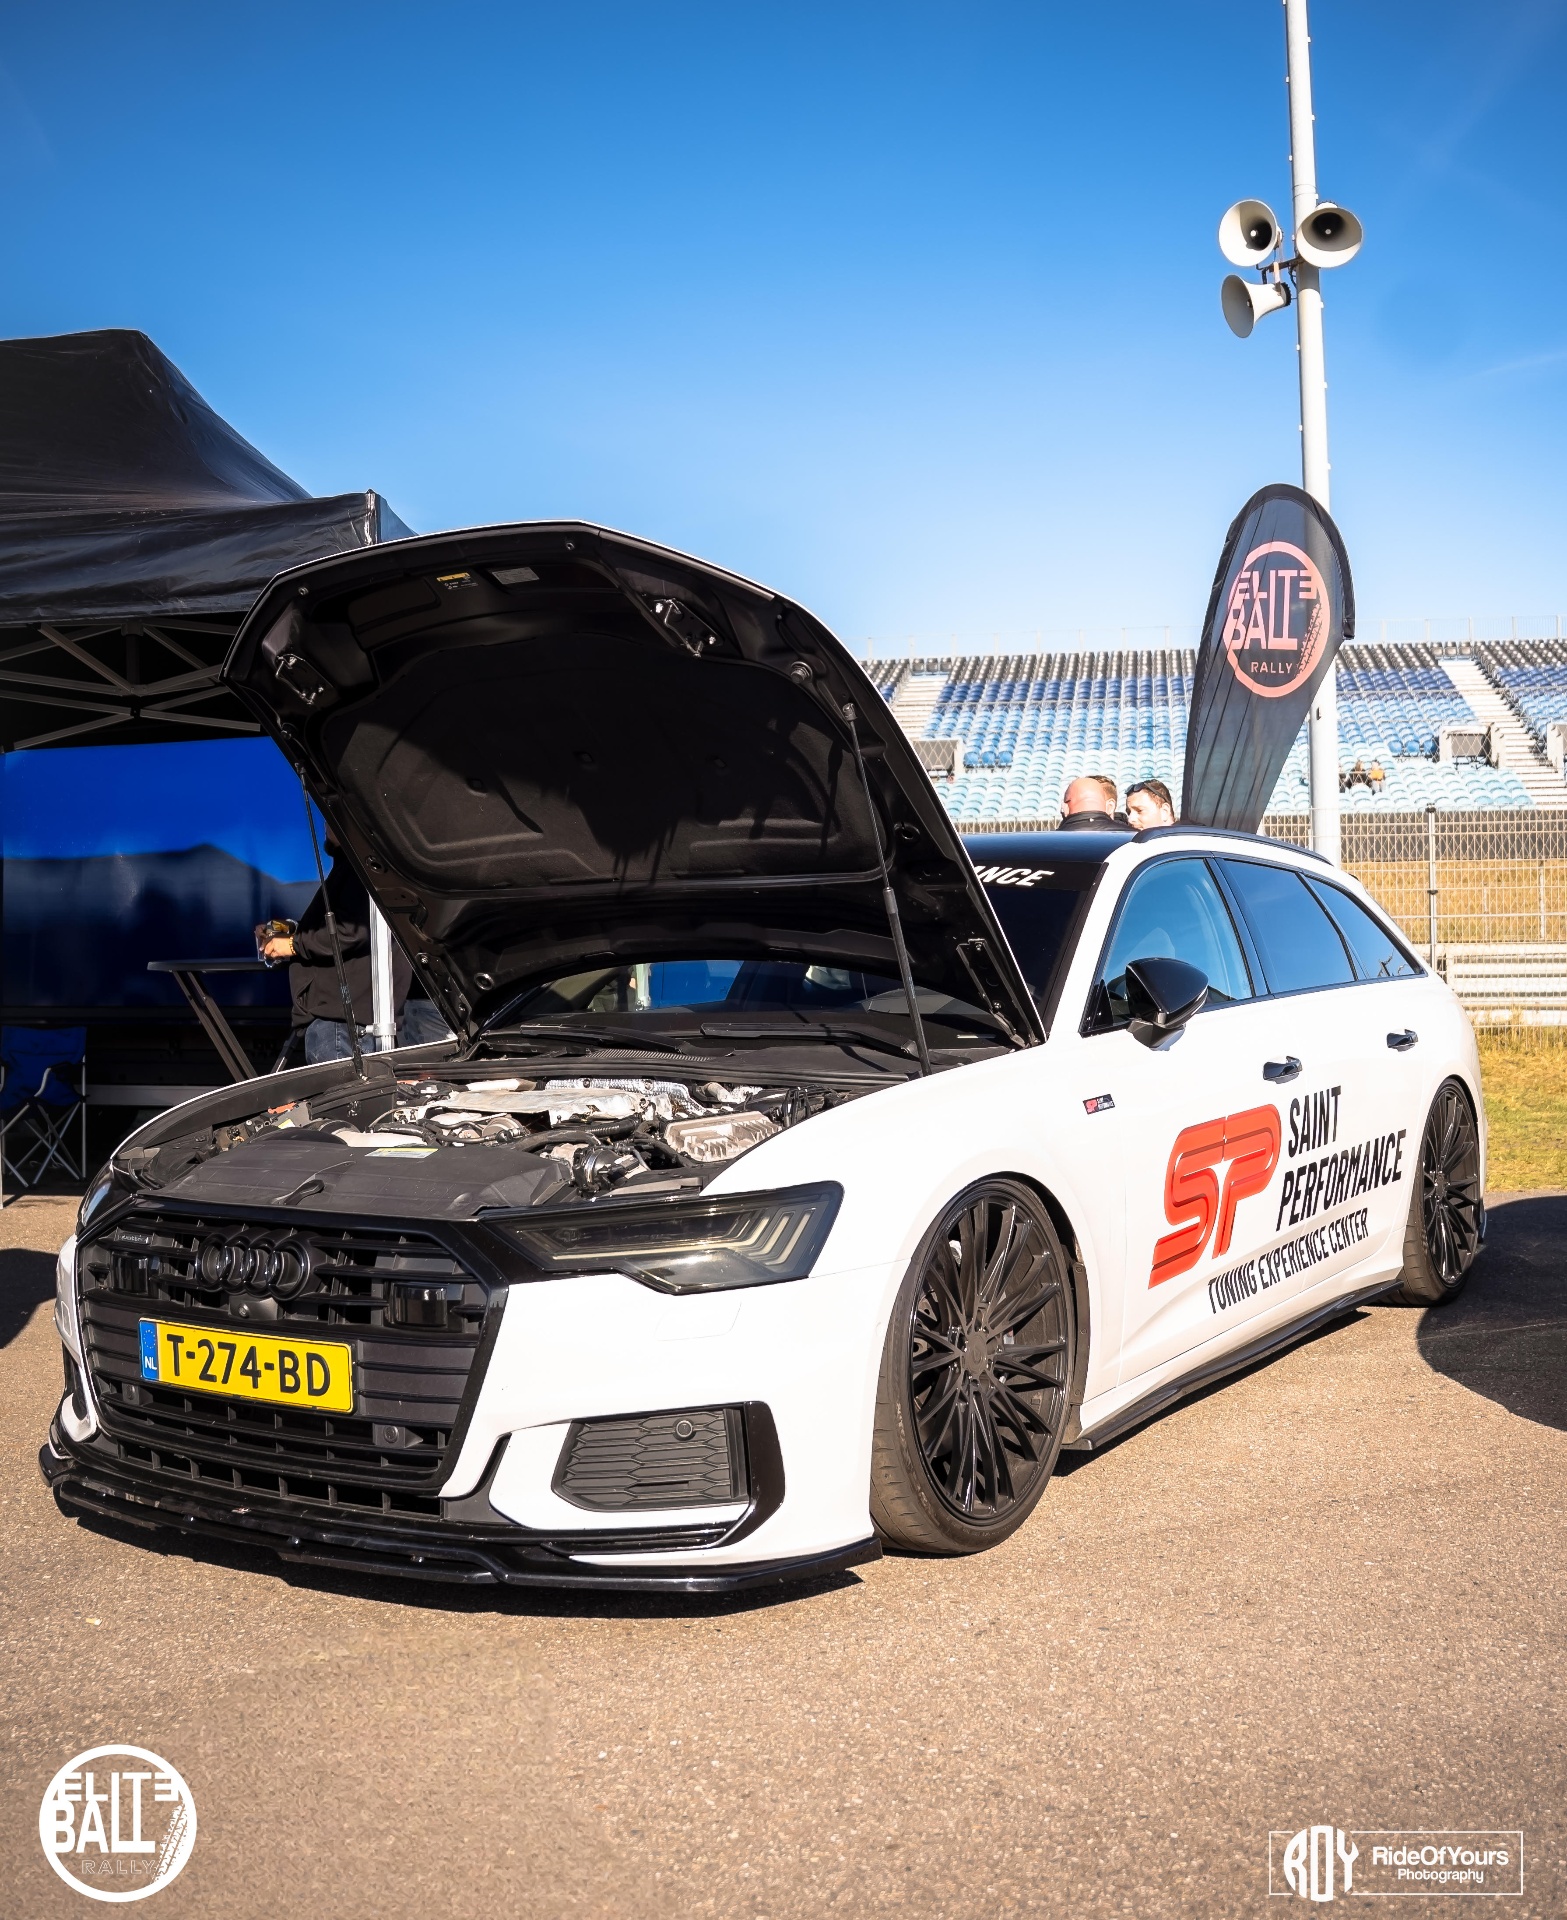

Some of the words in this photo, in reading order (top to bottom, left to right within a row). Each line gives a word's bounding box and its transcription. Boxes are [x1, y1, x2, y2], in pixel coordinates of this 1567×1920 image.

[1237, 569, 1317, 600] ELITE
[1223, 598, 1298, 650] BALL
[1251, 661, 1293, 674] RALLY
[1288, 1085, 1342, 1158] SAINT
[1148, 1103, 1282, 1289] SP
[1275, 1128, 1407, 1232] PERFORMANCE
[1207, 1259, 1258, 1314] TUNING
[1259, 1225, 1329, 1290] EXPERIENCE
[1328, 1207, 1369, 1254] CENTER
[144, 1355, 158, 1371] NL
[166, 1334, 331, 1397] T-274-BD
